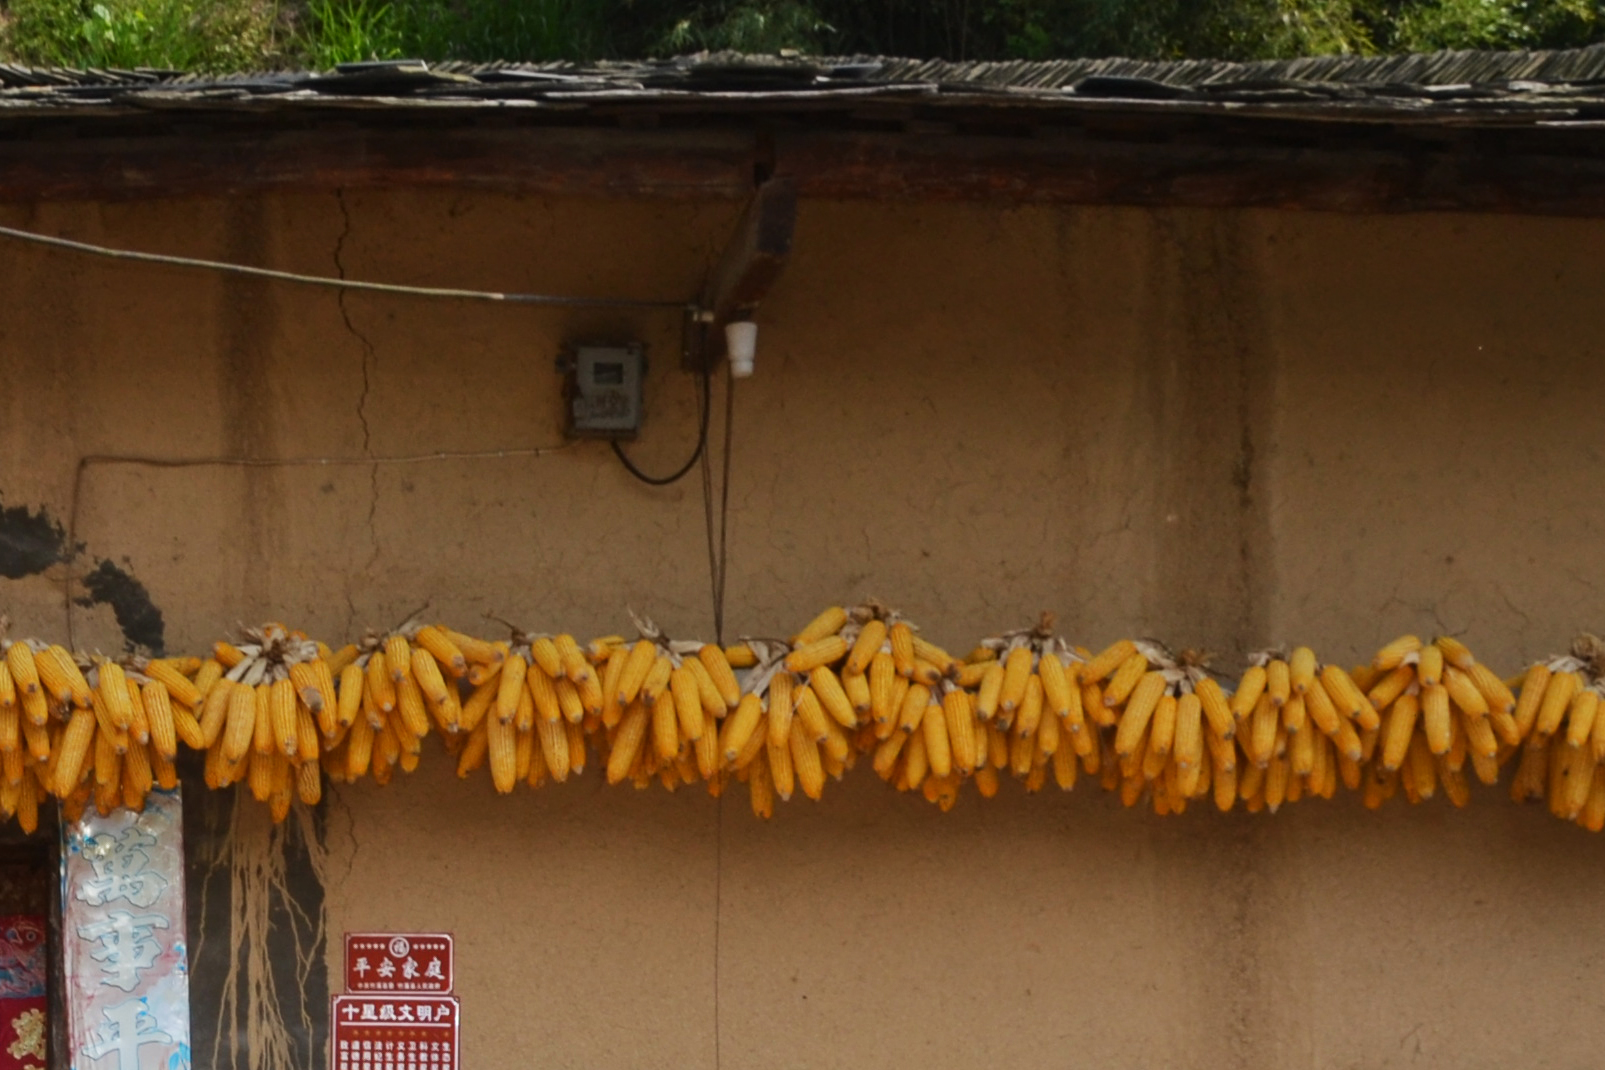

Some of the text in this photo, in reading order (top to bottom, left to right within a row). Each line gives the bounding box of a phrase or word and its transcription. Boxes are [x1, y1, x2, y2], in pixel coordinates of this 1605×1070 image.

[353, 956, 445, 980] 平安家庭
[342, 1003, 451, 1022] 十星级文明户
